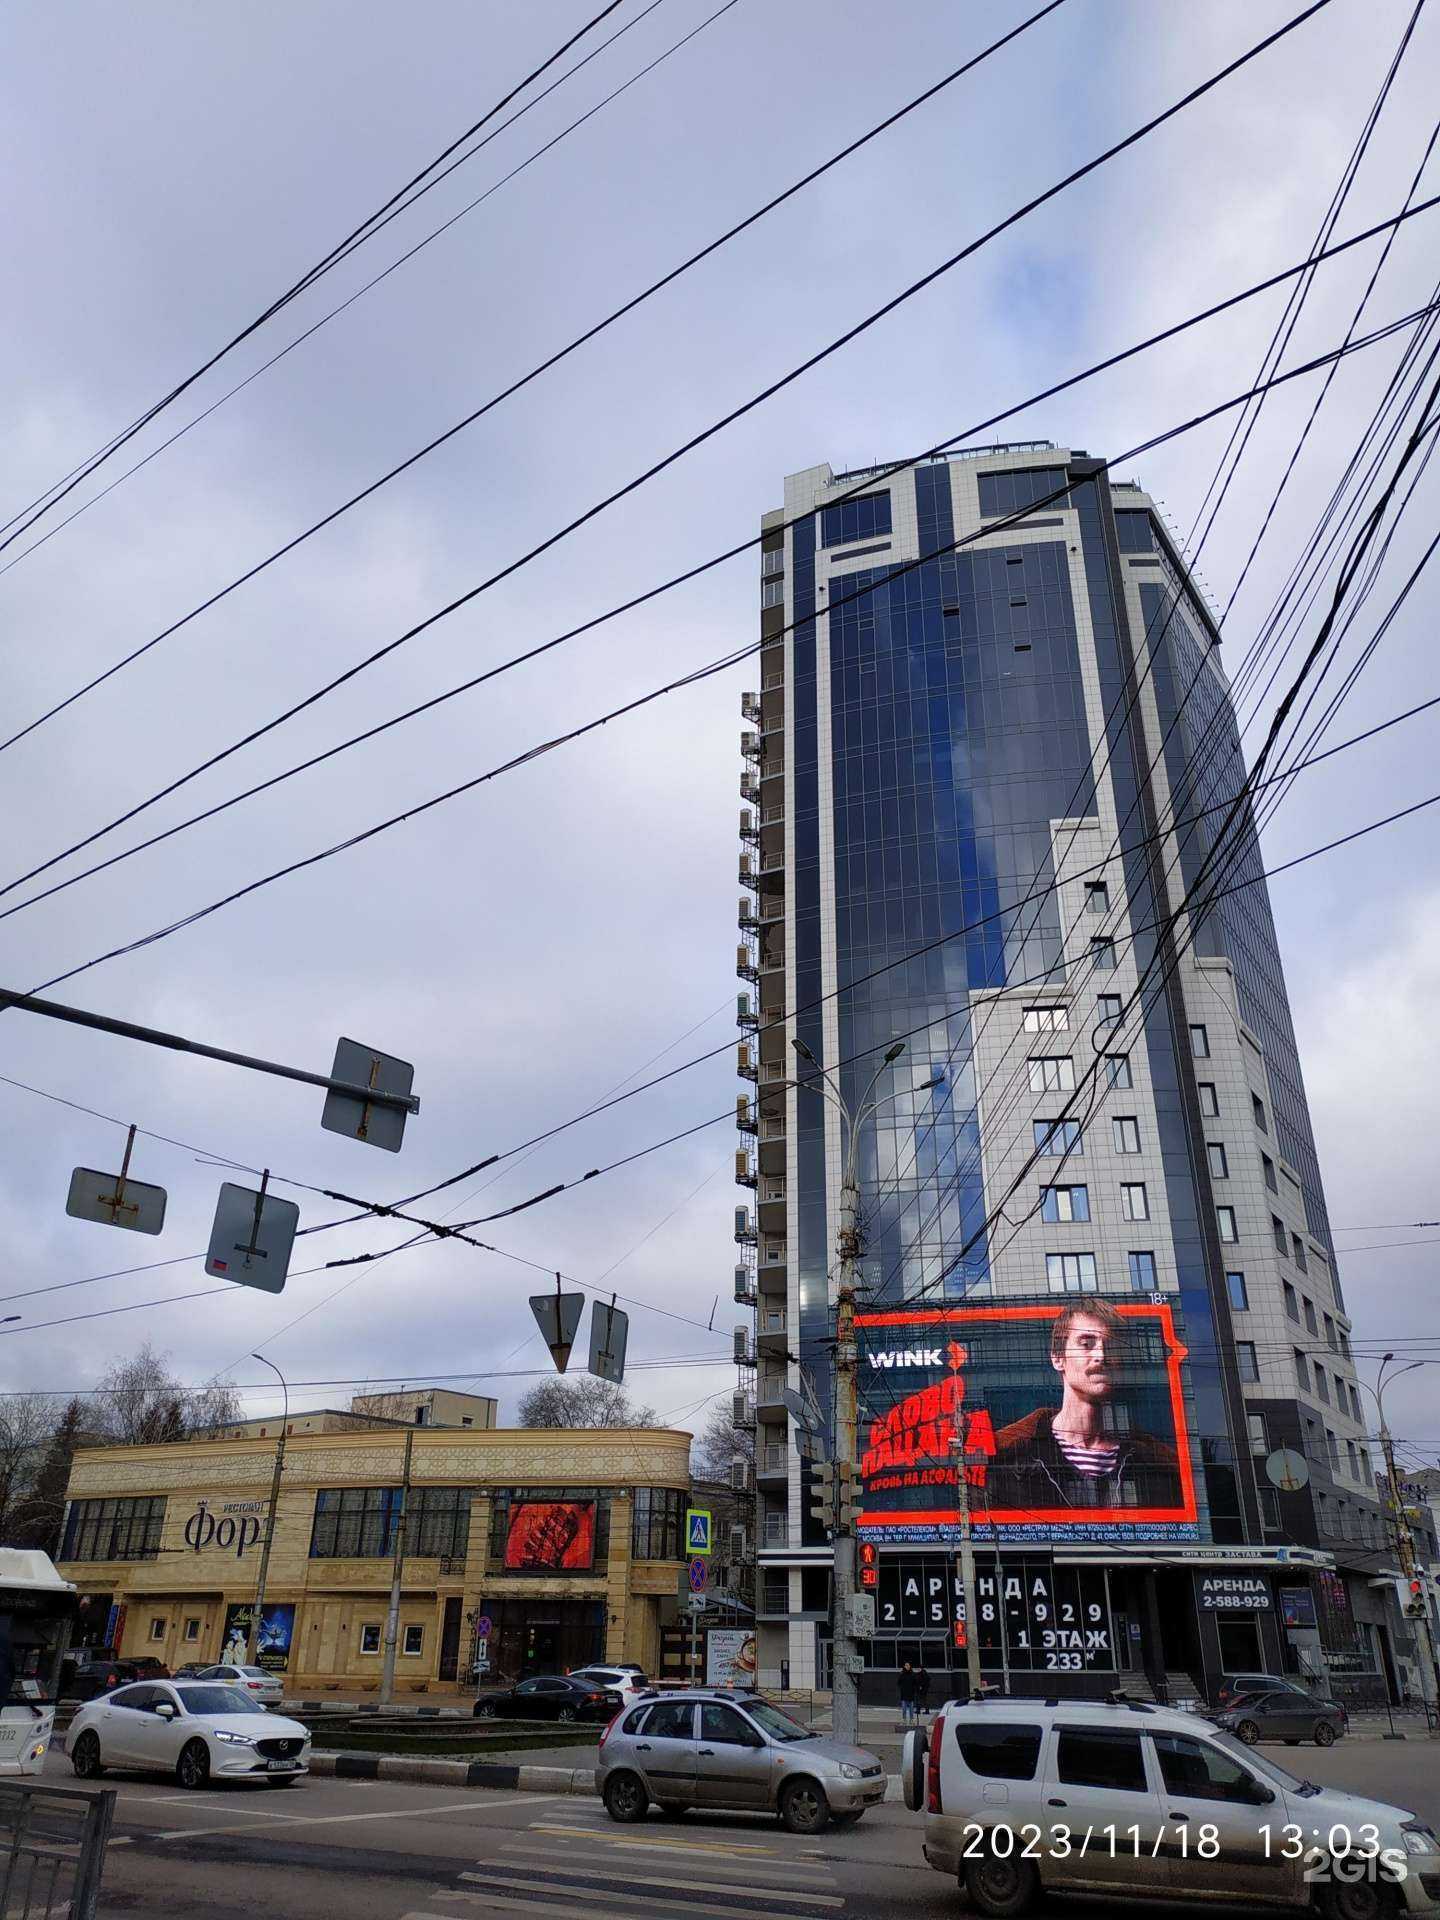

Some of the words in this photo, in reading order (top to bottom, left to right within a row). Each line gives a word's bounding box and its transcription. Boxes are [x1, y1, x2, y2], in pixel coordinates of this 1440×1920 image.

[1150, 1292, 1168, 1305] 18+
[868, 1348, 943, 1368] WINK
[869, 1374, 965, 1447] СЛОВО
[869, 1474, 902, 1492] КРОВЬ
[904, 1471, 919, 1486] НА
[1202, 1579, 1266, 1593] АРЕНДА
[1203, 1596, 1269, 1608] 2-588-929
[1018, 1631, 1030, 1648] 1
[1042, 1630, 1108, 1648] ЭТАЖ
[1046, 1653, 1083, 1670] 233
